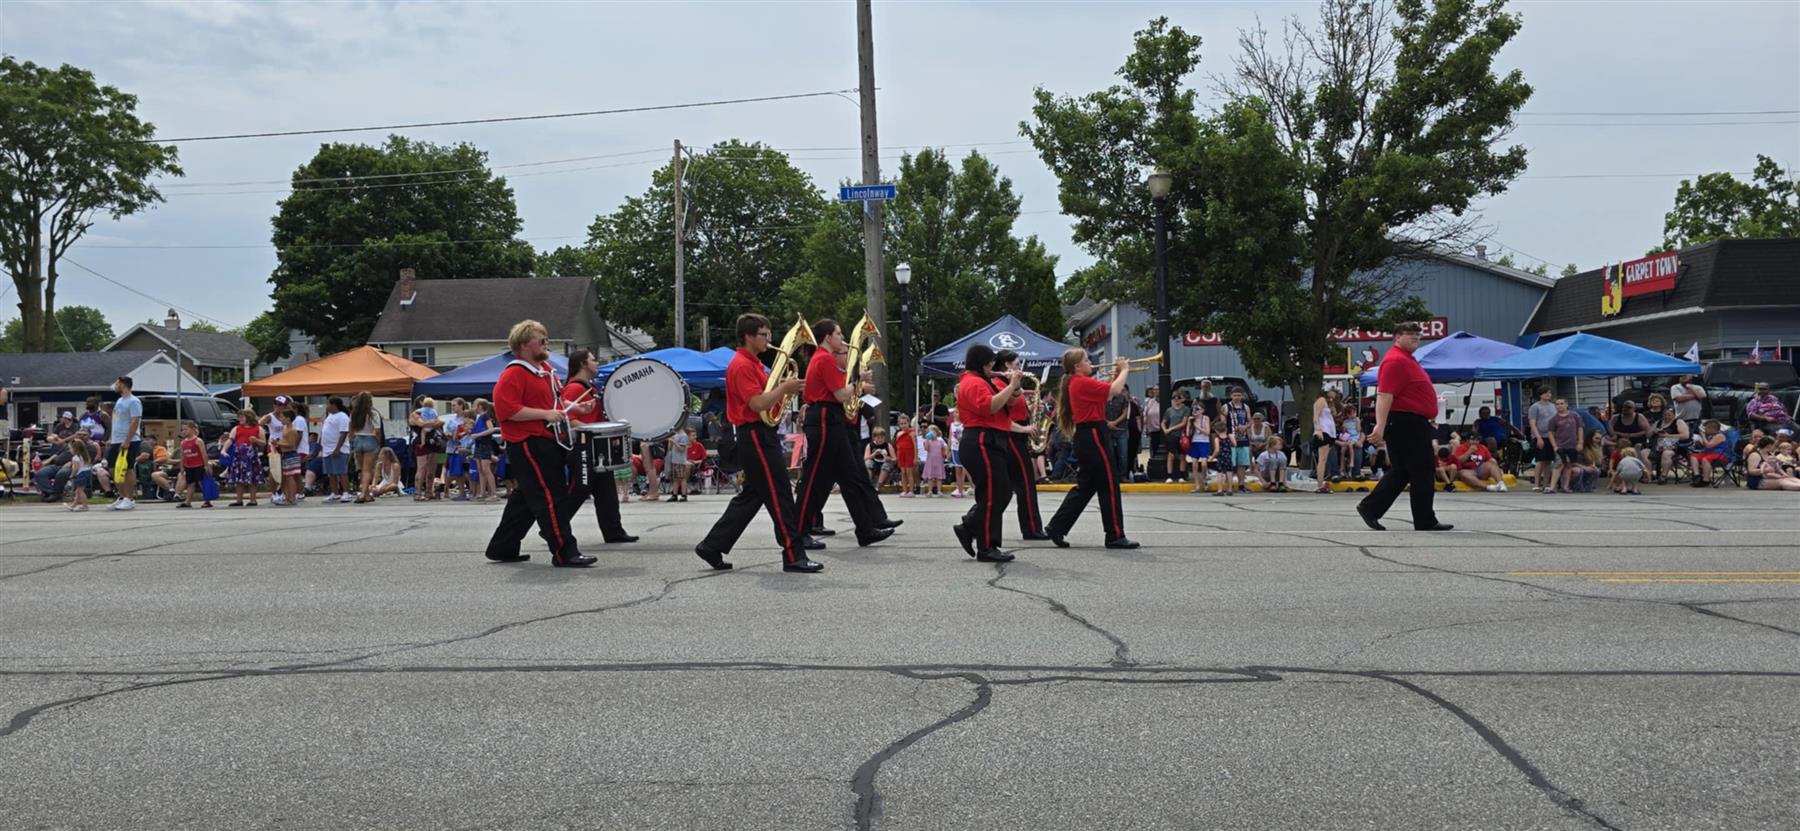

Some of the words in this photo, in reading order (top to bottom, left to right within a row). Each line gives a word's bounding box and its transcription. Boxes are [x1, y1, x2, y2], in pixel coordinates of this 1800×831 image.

[847, 188, 889, 199] Lincolnway
[1626, 261, 1654, 282] CARPET
[1656, 255, 1678, 276] TOWN
[622, 366, 655, 385] YAMAHA
